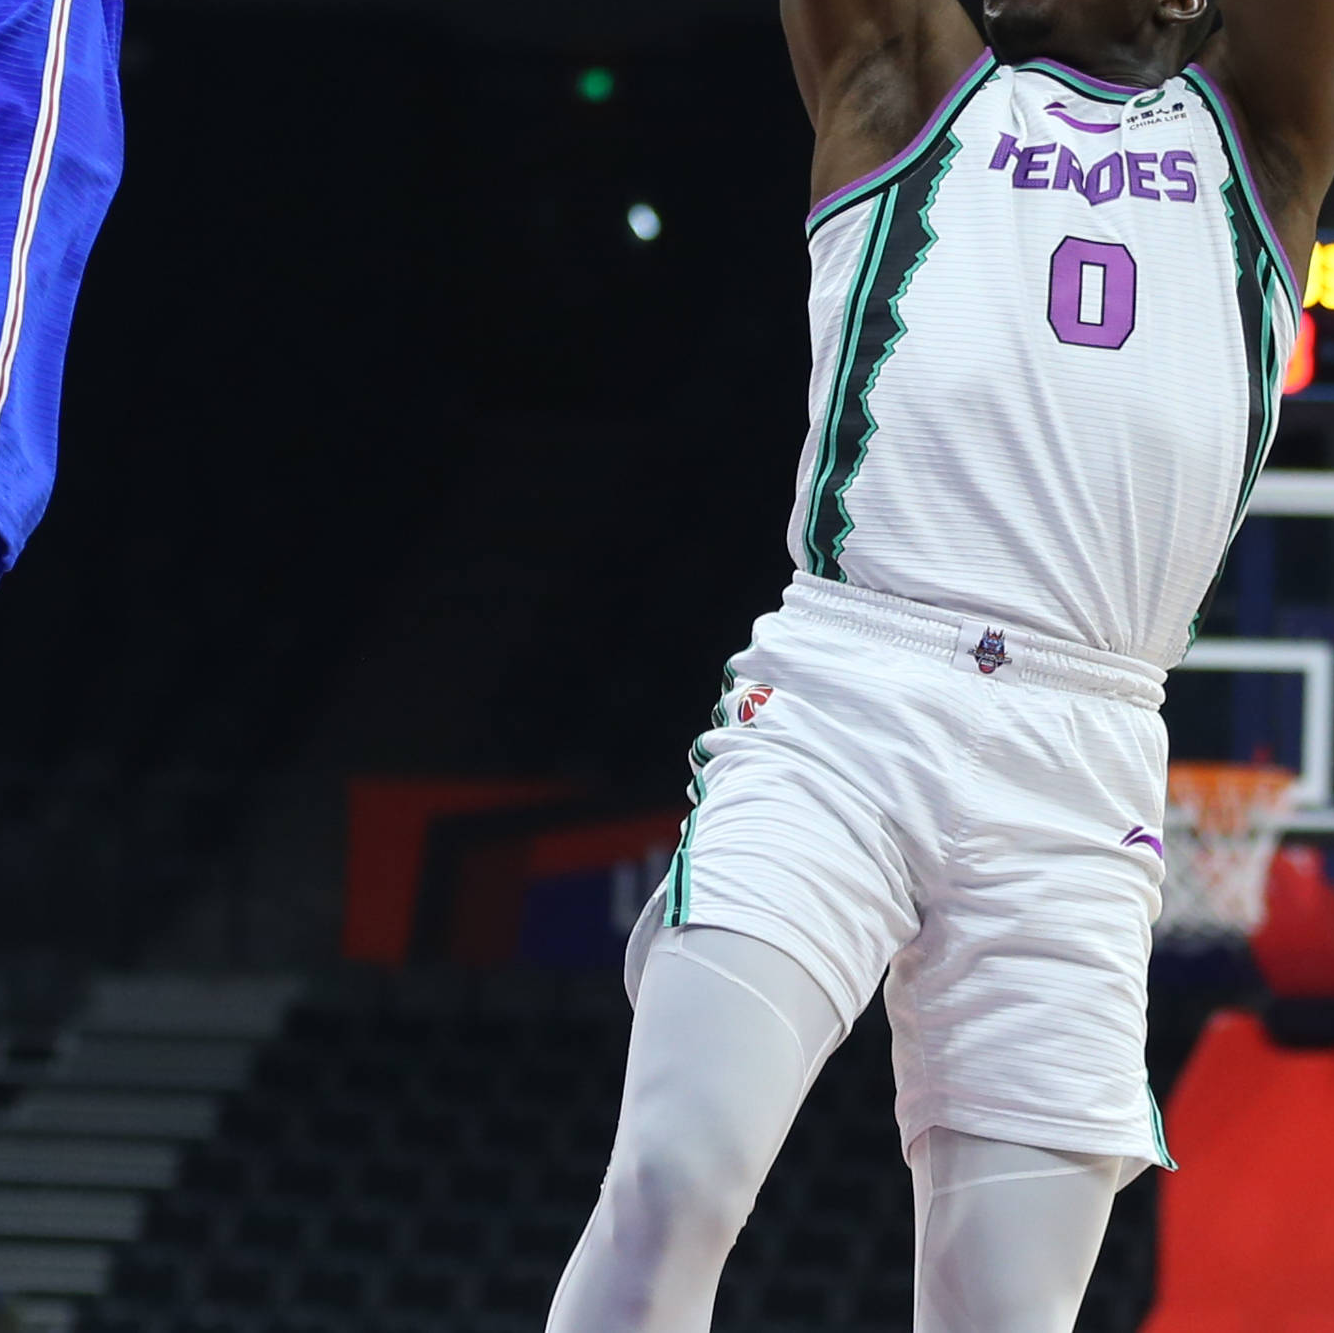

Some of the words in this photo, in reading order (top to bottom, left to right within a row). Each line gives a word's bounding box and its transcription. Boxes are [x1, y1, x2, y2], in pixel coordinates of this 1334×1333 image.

[1129, 117, 1163, 131] CHINA
[1164, 111, 1188, 122] LIFE
[1047, 234, 1137, 351] 0
